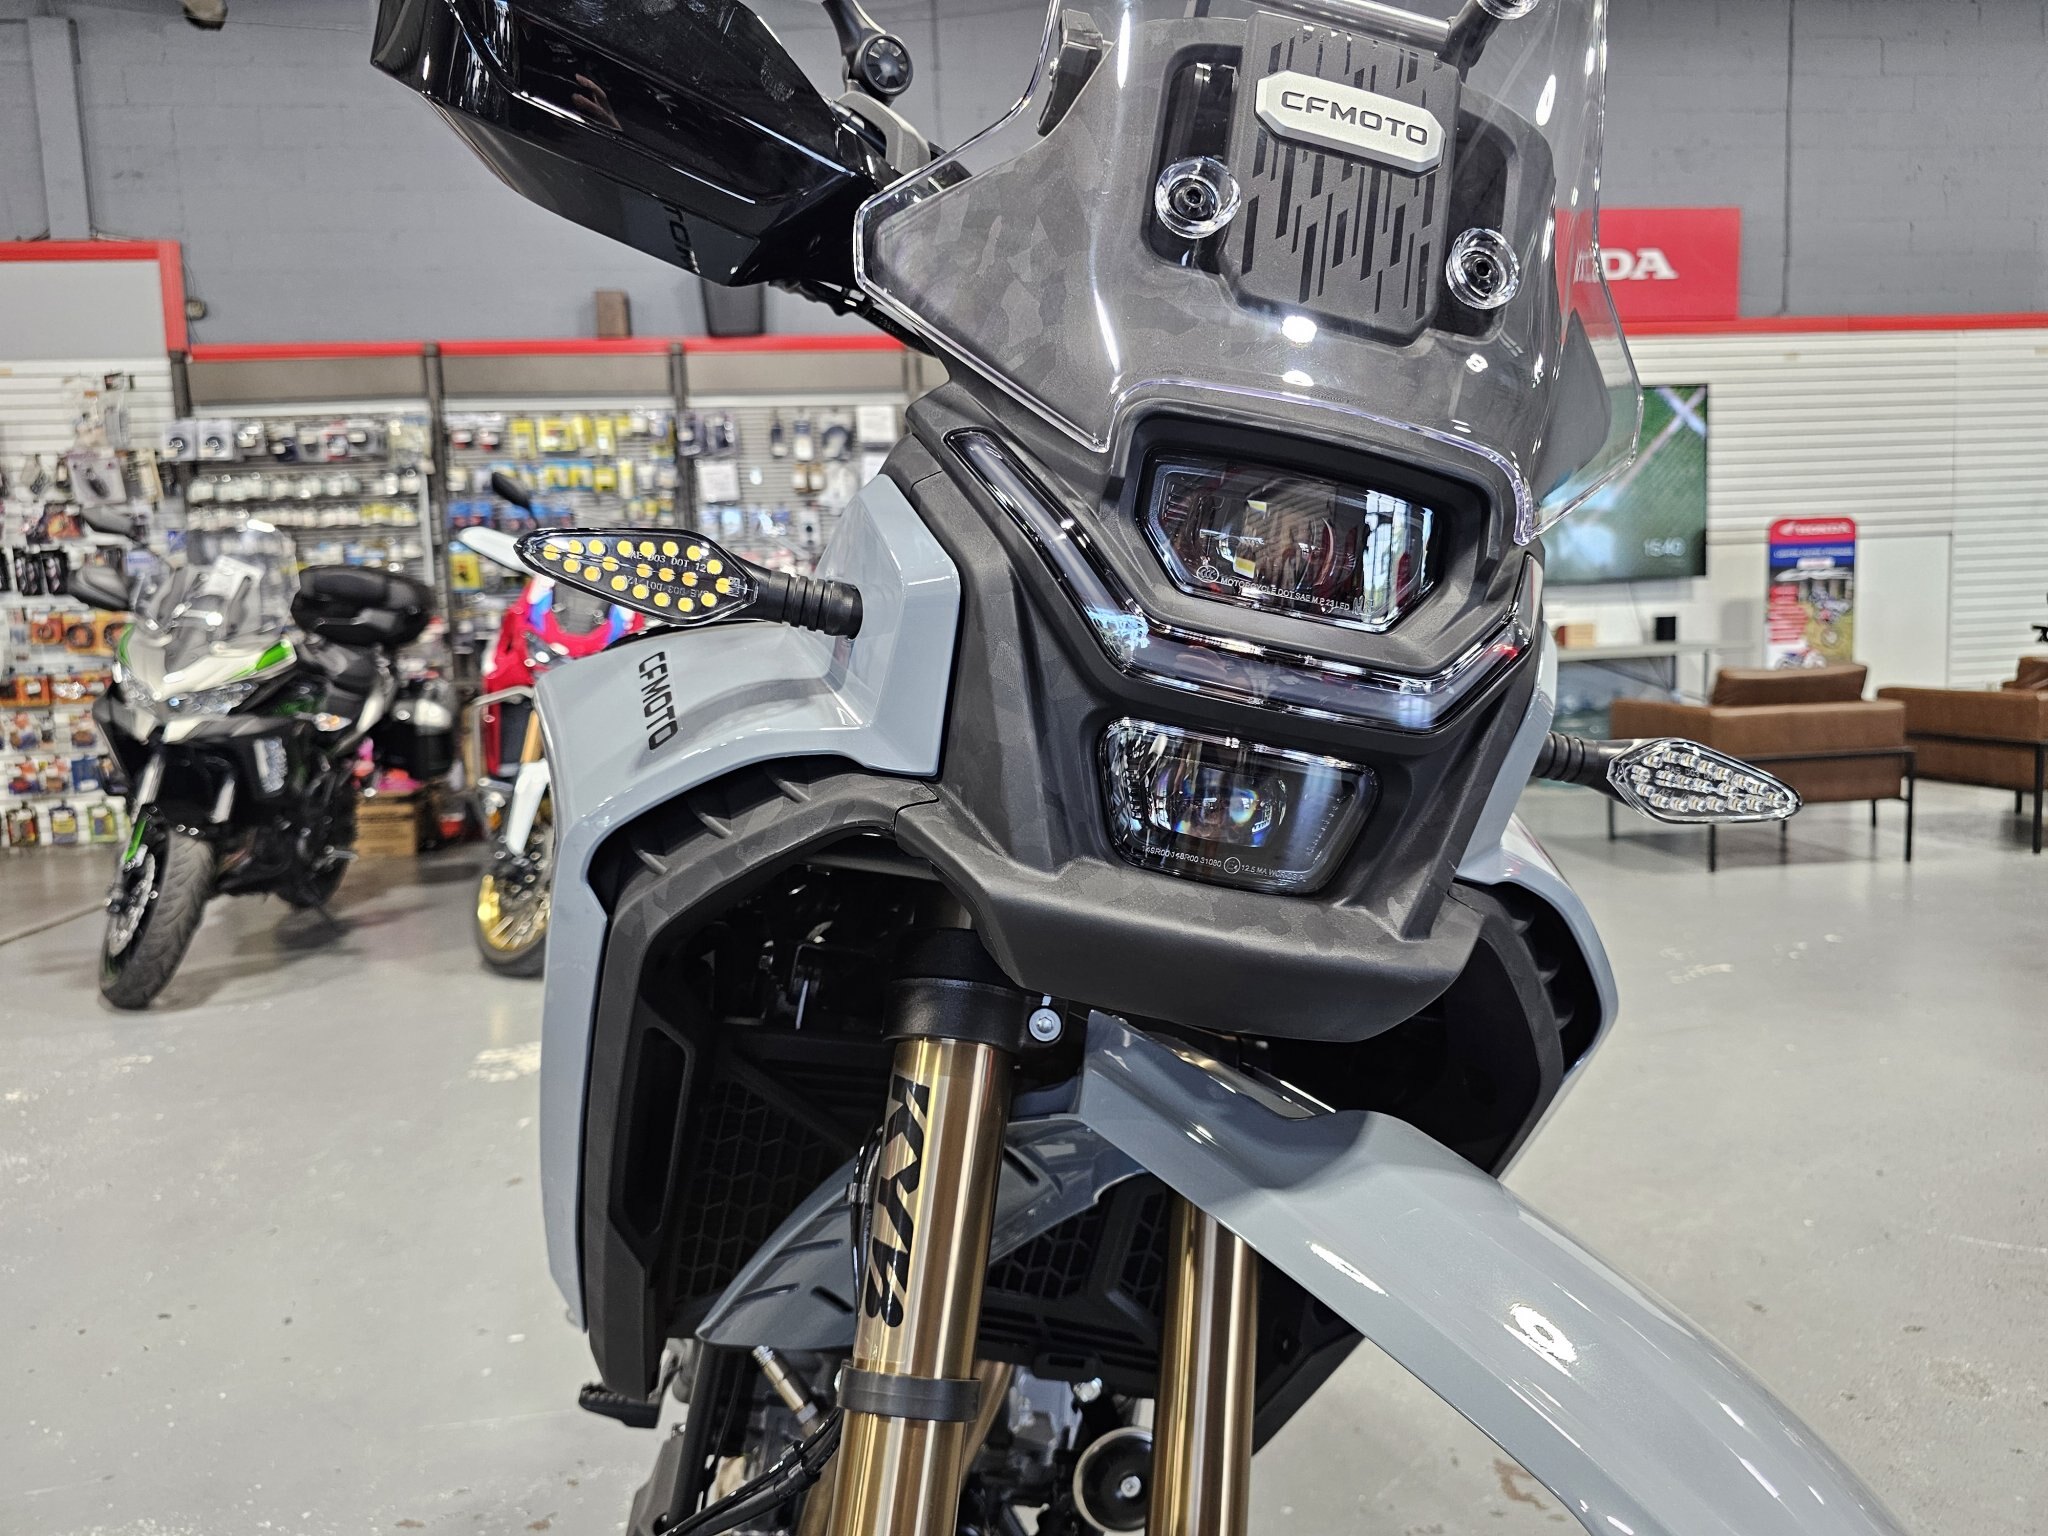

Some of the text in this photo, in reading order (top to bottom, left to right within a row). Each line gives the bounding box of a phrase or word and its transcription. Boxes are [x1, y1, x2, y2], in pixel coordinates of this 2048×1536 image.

[1280, 91, 1428, 146] CFMOTO
[670, 558, 690, 568] DOT
[695, 562, 707, 573] 12
[1220, 577, 1277, 595] MOTORCYCLE
[1277, 588, 1295, 599] DOT
[1295, 592, 1311, 602] SAE
[1335, 601, 1350, 611] LED
[638, 651, 679, 751] CFMOTO
